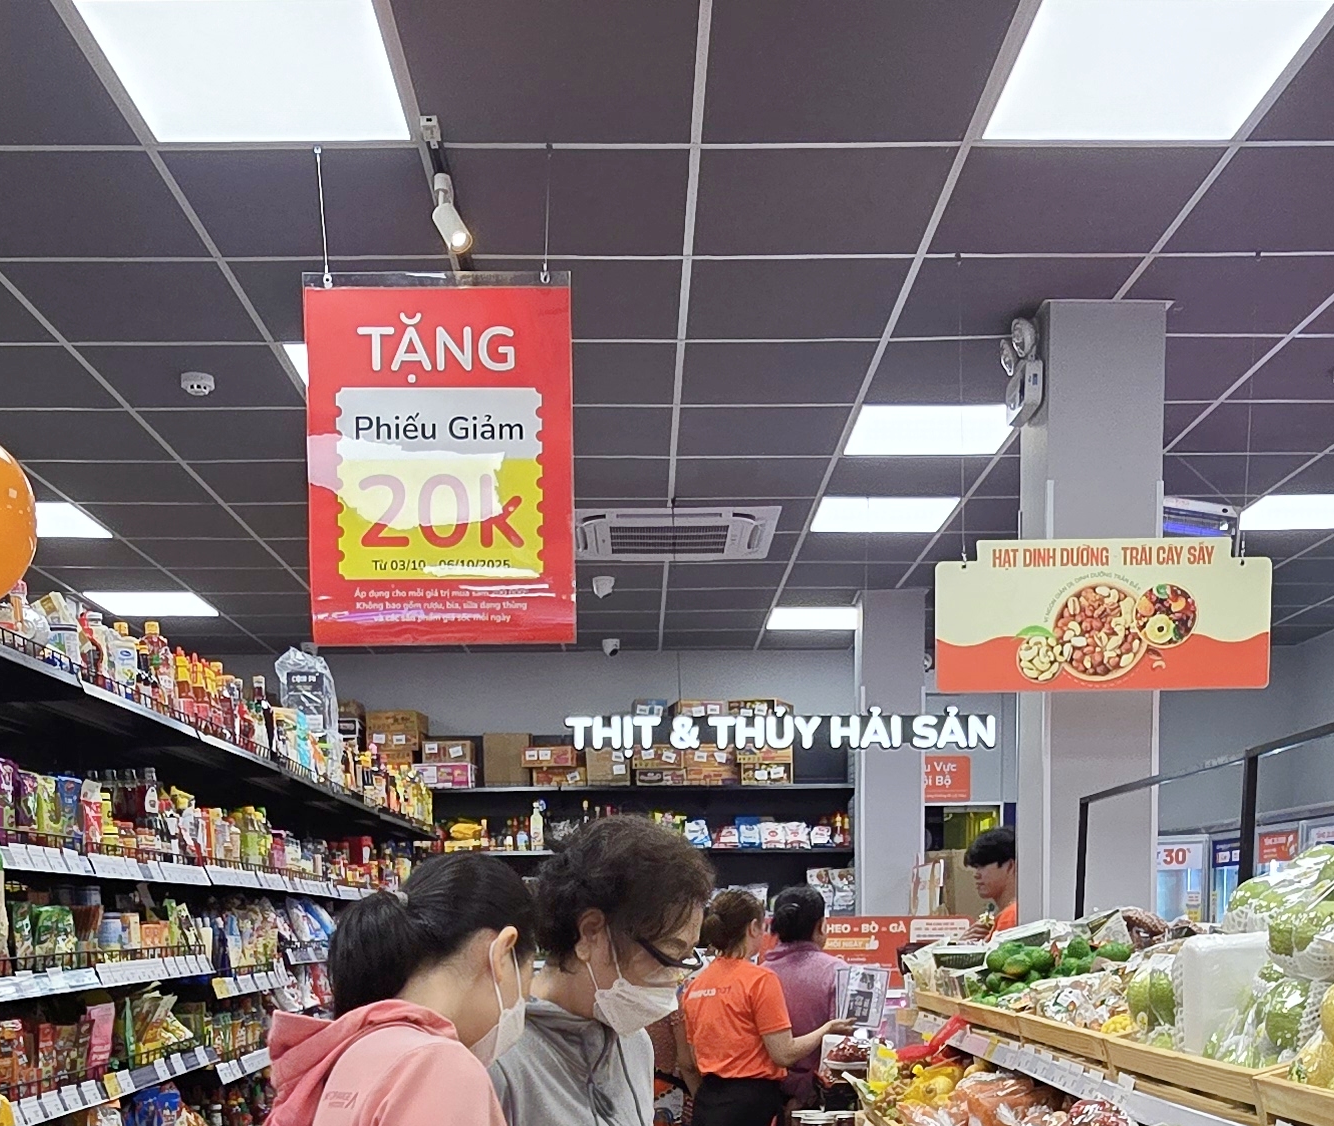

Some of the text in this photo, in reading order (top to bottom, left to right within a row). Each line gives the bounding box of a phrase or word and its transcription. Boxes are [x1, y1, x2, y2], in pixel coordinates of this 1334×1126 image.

[357, 311, 515, 383] TẶNG
[355, 412, 525, 442] Phiếu Giảm
[358, 473, 525, 549] 20k
[992, 546, 1018, 571] HẠT
[1023, 546, 1056, 568] DINH
[1060, 543, 1110, 568] DƯỠNG
[1121, 545, 1152, 567] TRÁI
[1156, 542, 1183, 567] CÂY
[565, 705, 997, 758] THỊT & THỦY HẢI SẢN
